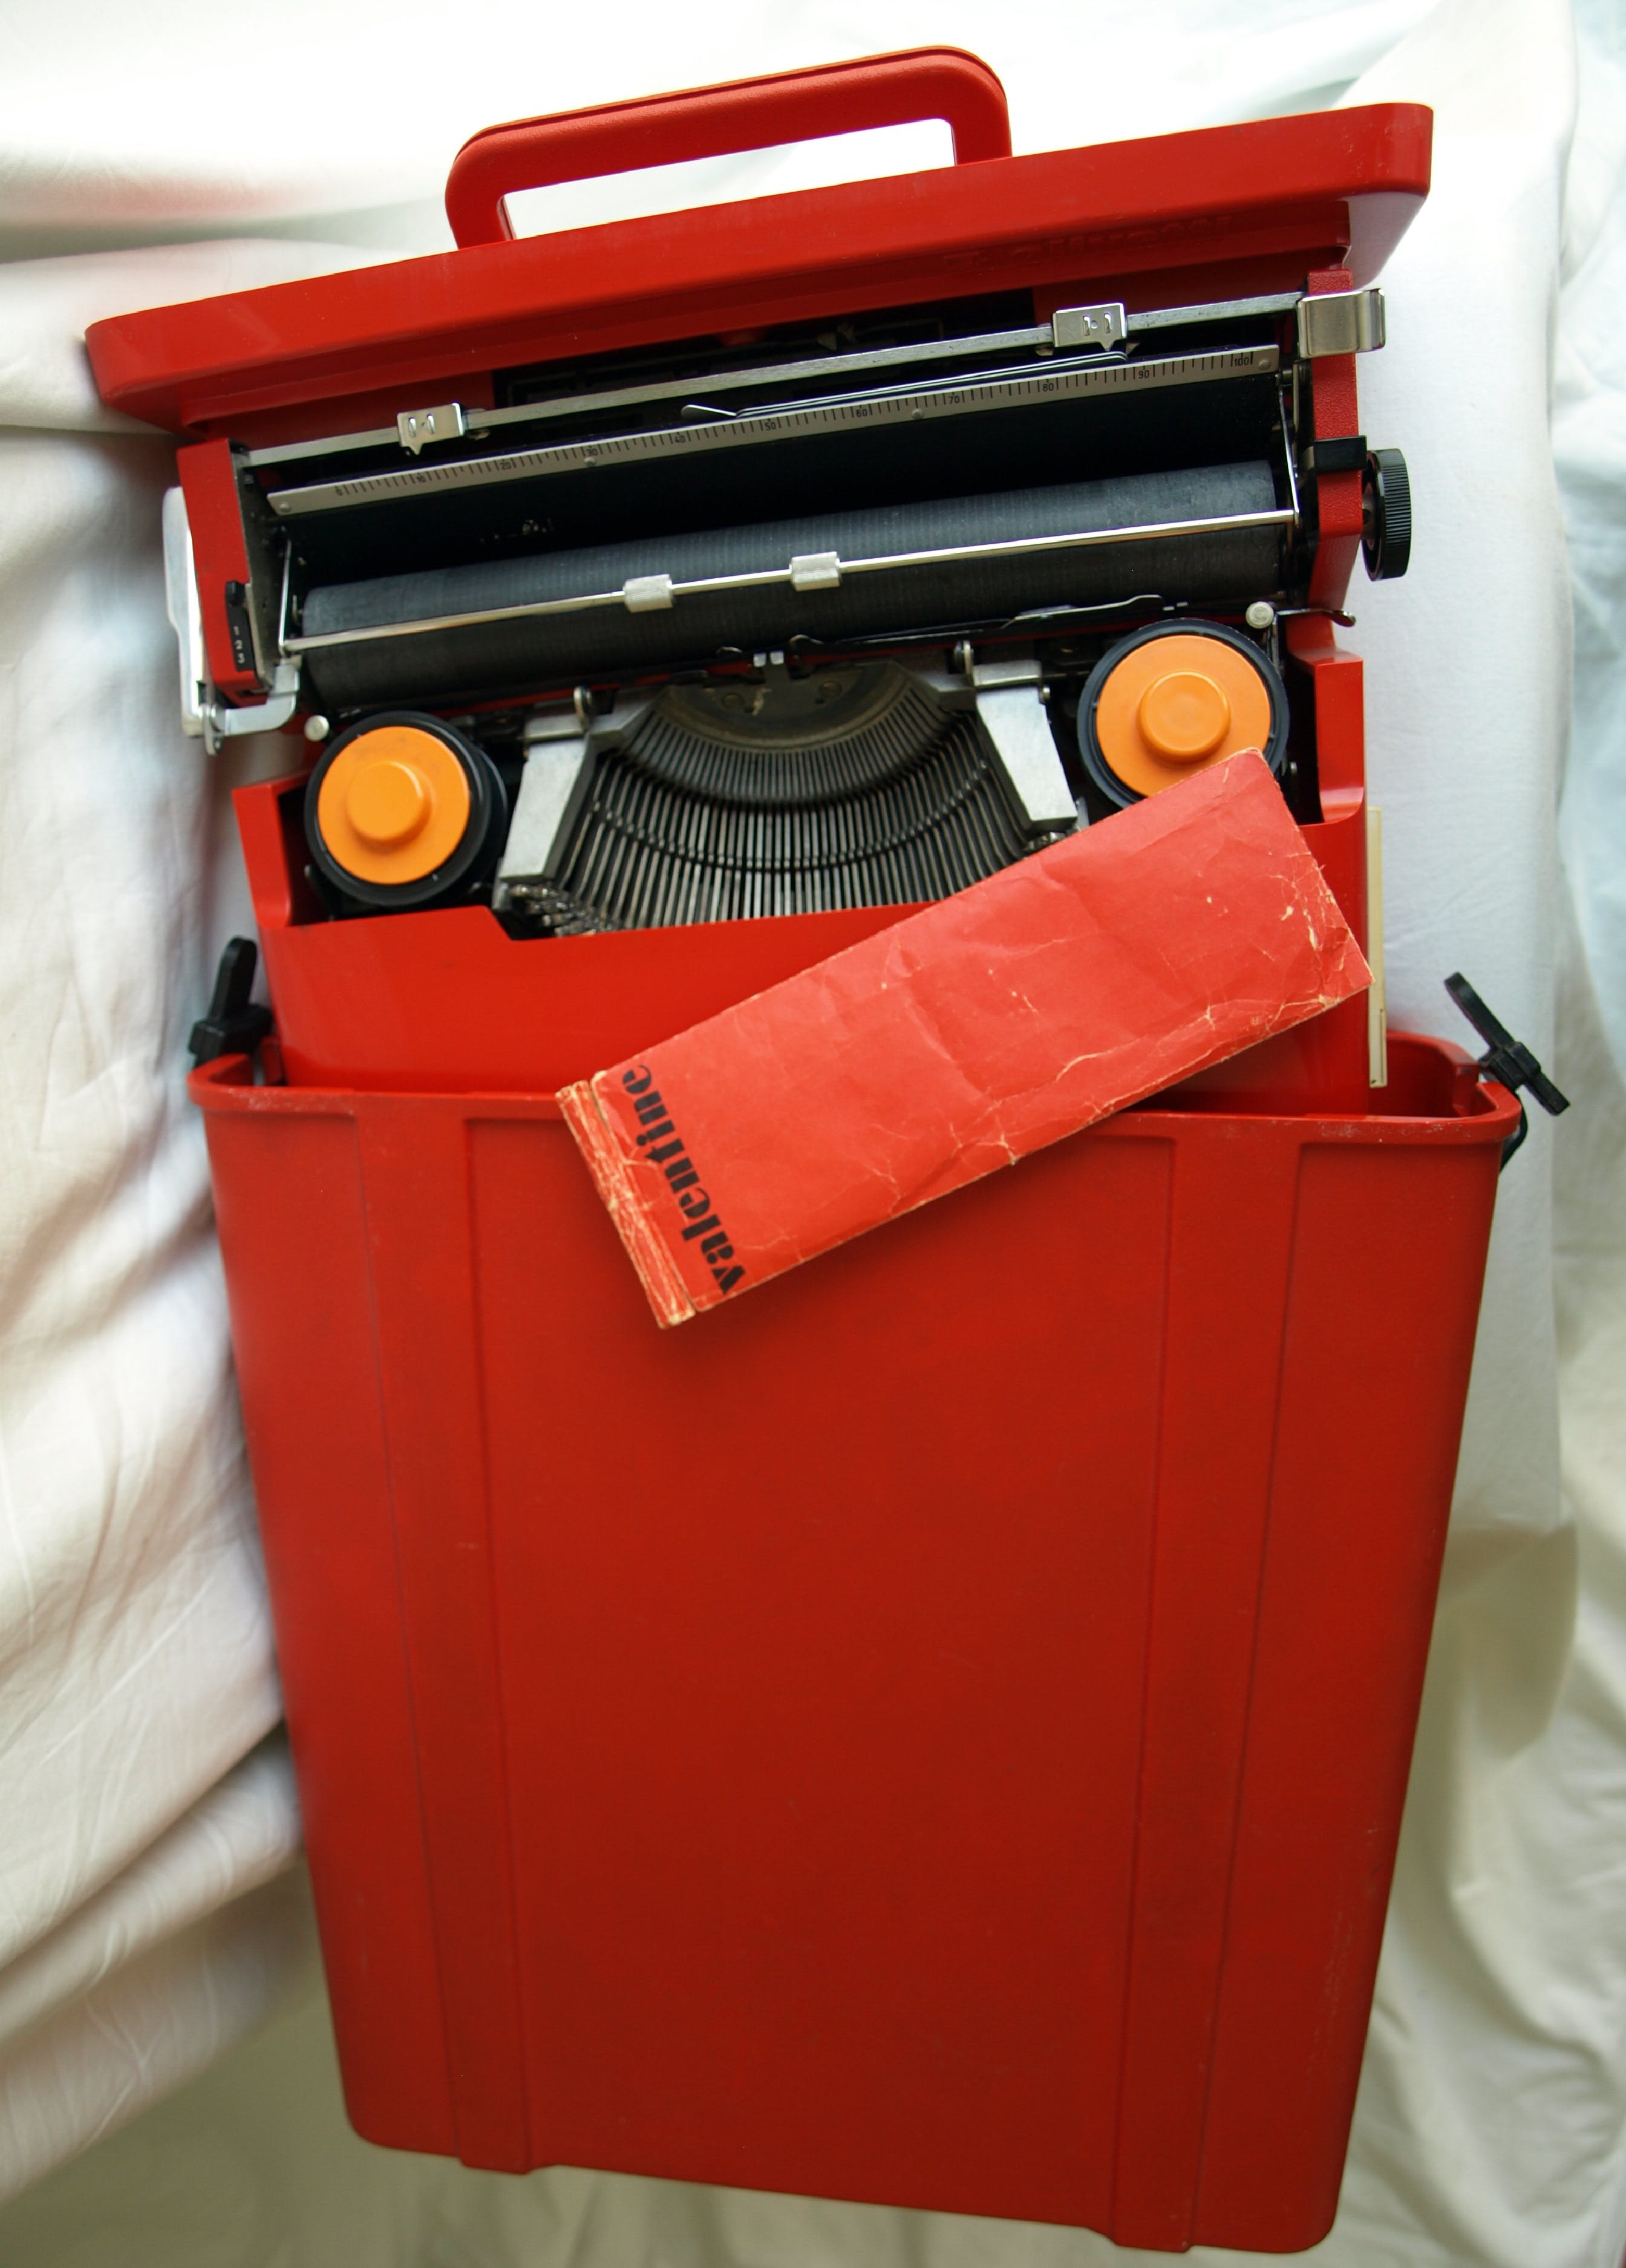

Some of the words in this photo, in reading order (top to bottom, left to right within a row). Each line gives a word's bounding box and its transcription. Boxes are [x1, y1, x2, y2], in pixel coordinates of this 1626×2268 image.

[500, 461, 512, 470] 20
[586, 448, 598, 456] 30
[765, 422, 775, 430] 50
[856, 408, 867, 417] 60
[948, 396, 959, 404] 70
[1043, 383, 1054, 392] 80
[1138, 370, 1149, 379] 90
[1235, 357, 1249, 367] 100
[235, 639, 243, 650] 2
[237, 653, 246, 664] 3
[622, 1064, 746, 1294] valentine
